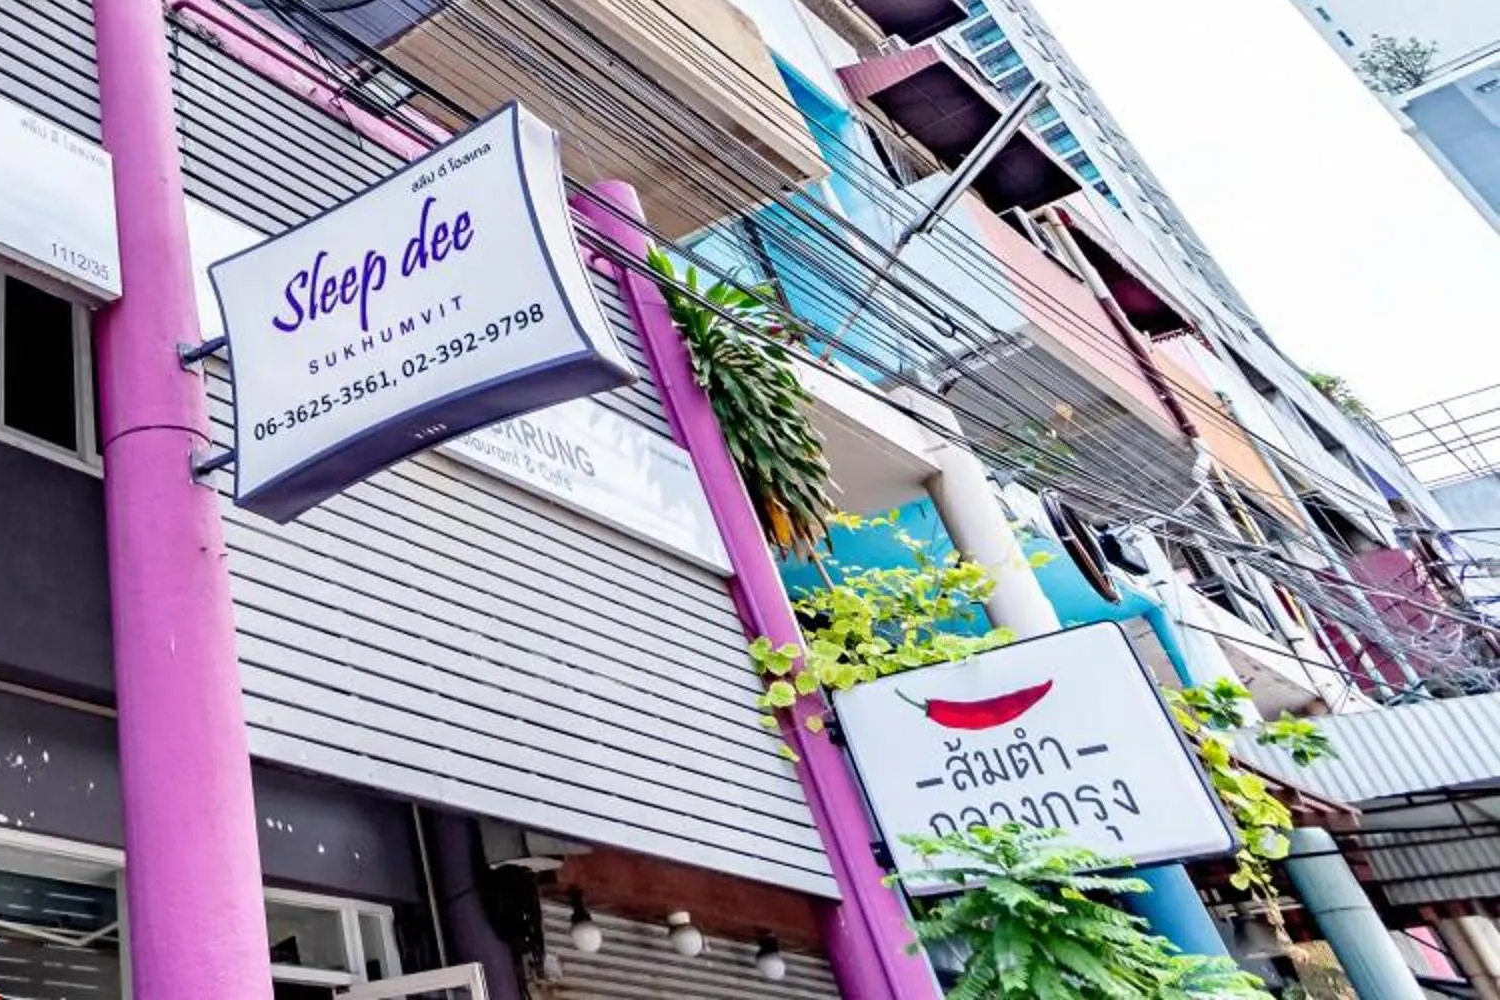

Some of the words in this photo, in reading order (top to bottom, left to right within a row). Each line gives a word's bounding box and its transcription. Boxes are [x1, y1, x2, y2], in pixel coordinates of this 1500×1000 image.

[51, 243, 109, 280] 1112/35
[272, 250, 386, 332] Sleep
[401, 197, 474, 277] dee
[254, 370, 397, 441] 06-3625-3561,
[402, 303, 545, 378] 02-392-9798
[309, 295, 463, 375] SUKHUMVIT
[492, 419, 595, 477] KRUNG
